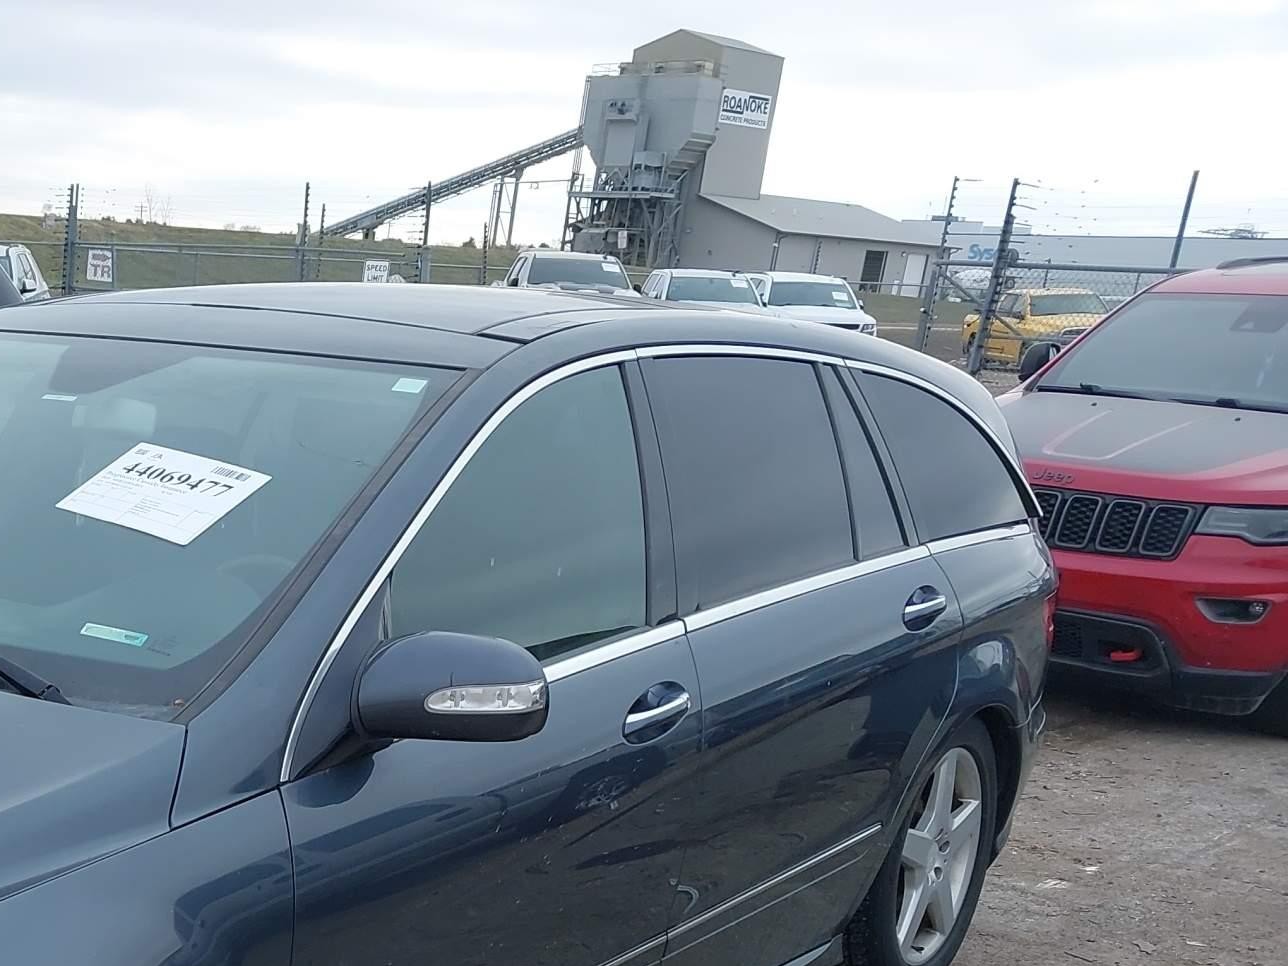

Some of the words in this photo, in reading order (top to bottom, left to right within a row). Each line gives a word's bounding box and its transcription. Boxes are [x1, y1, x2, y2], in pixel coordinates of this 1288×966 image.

[723, 95, 769, 115] ROANOKE
[366, 264, 388, 272] SPEED
[123, 462, 234, 497] 44069477
[1032, 467, 1075, 484] Jeep
